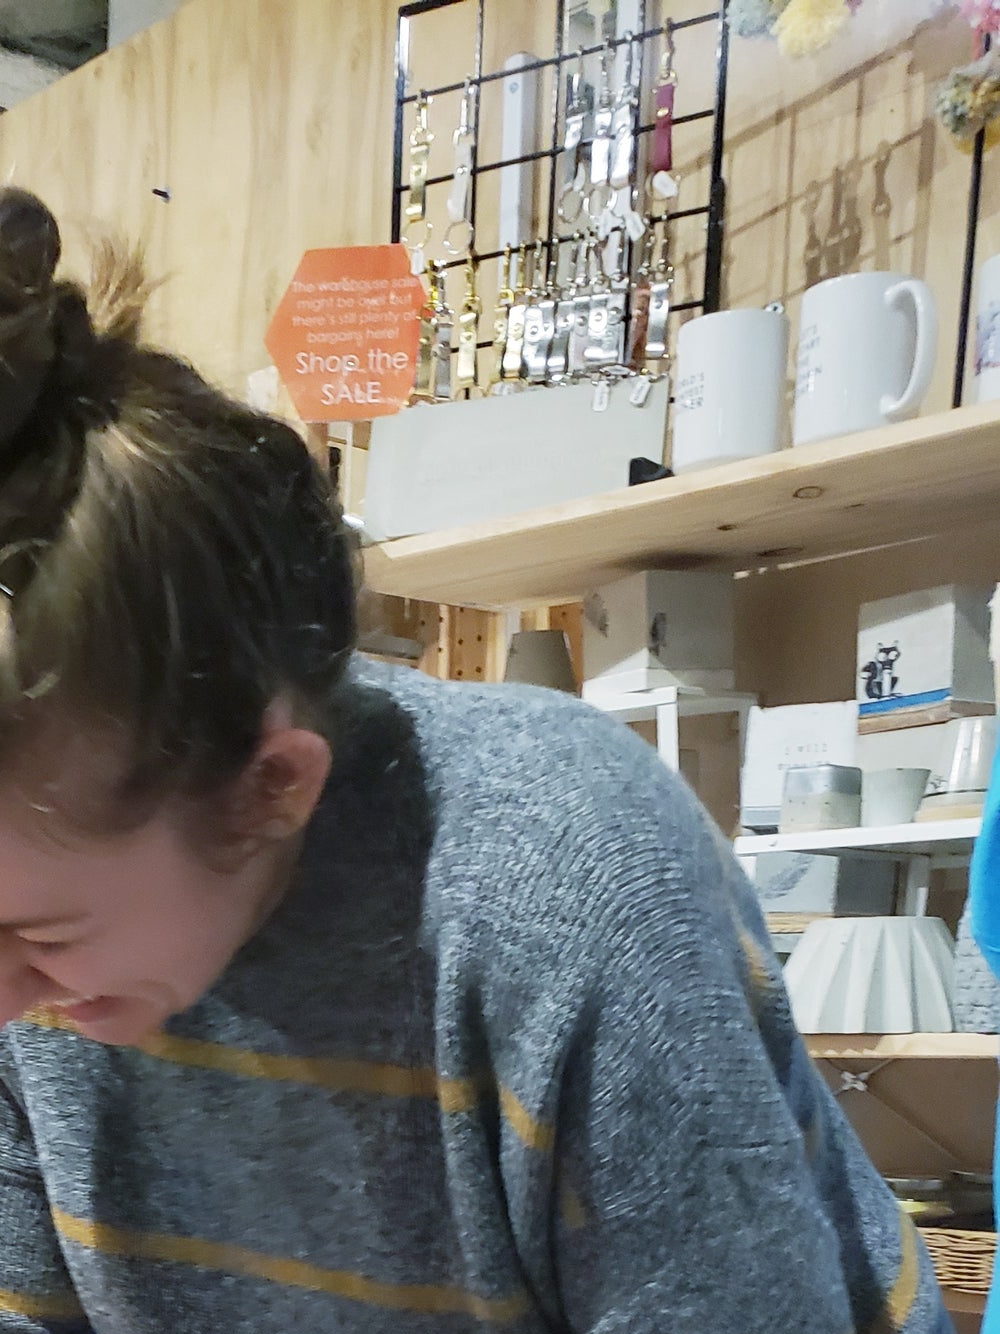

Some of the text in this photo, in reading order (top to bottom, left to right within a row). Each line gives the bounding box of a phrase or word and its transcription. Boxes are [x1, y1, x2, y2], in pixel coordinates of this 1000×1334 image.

[389, 290, 413, 305] but
[296, 349, 409, 376] Shop the
[320, 382, 381, 405] SALE
